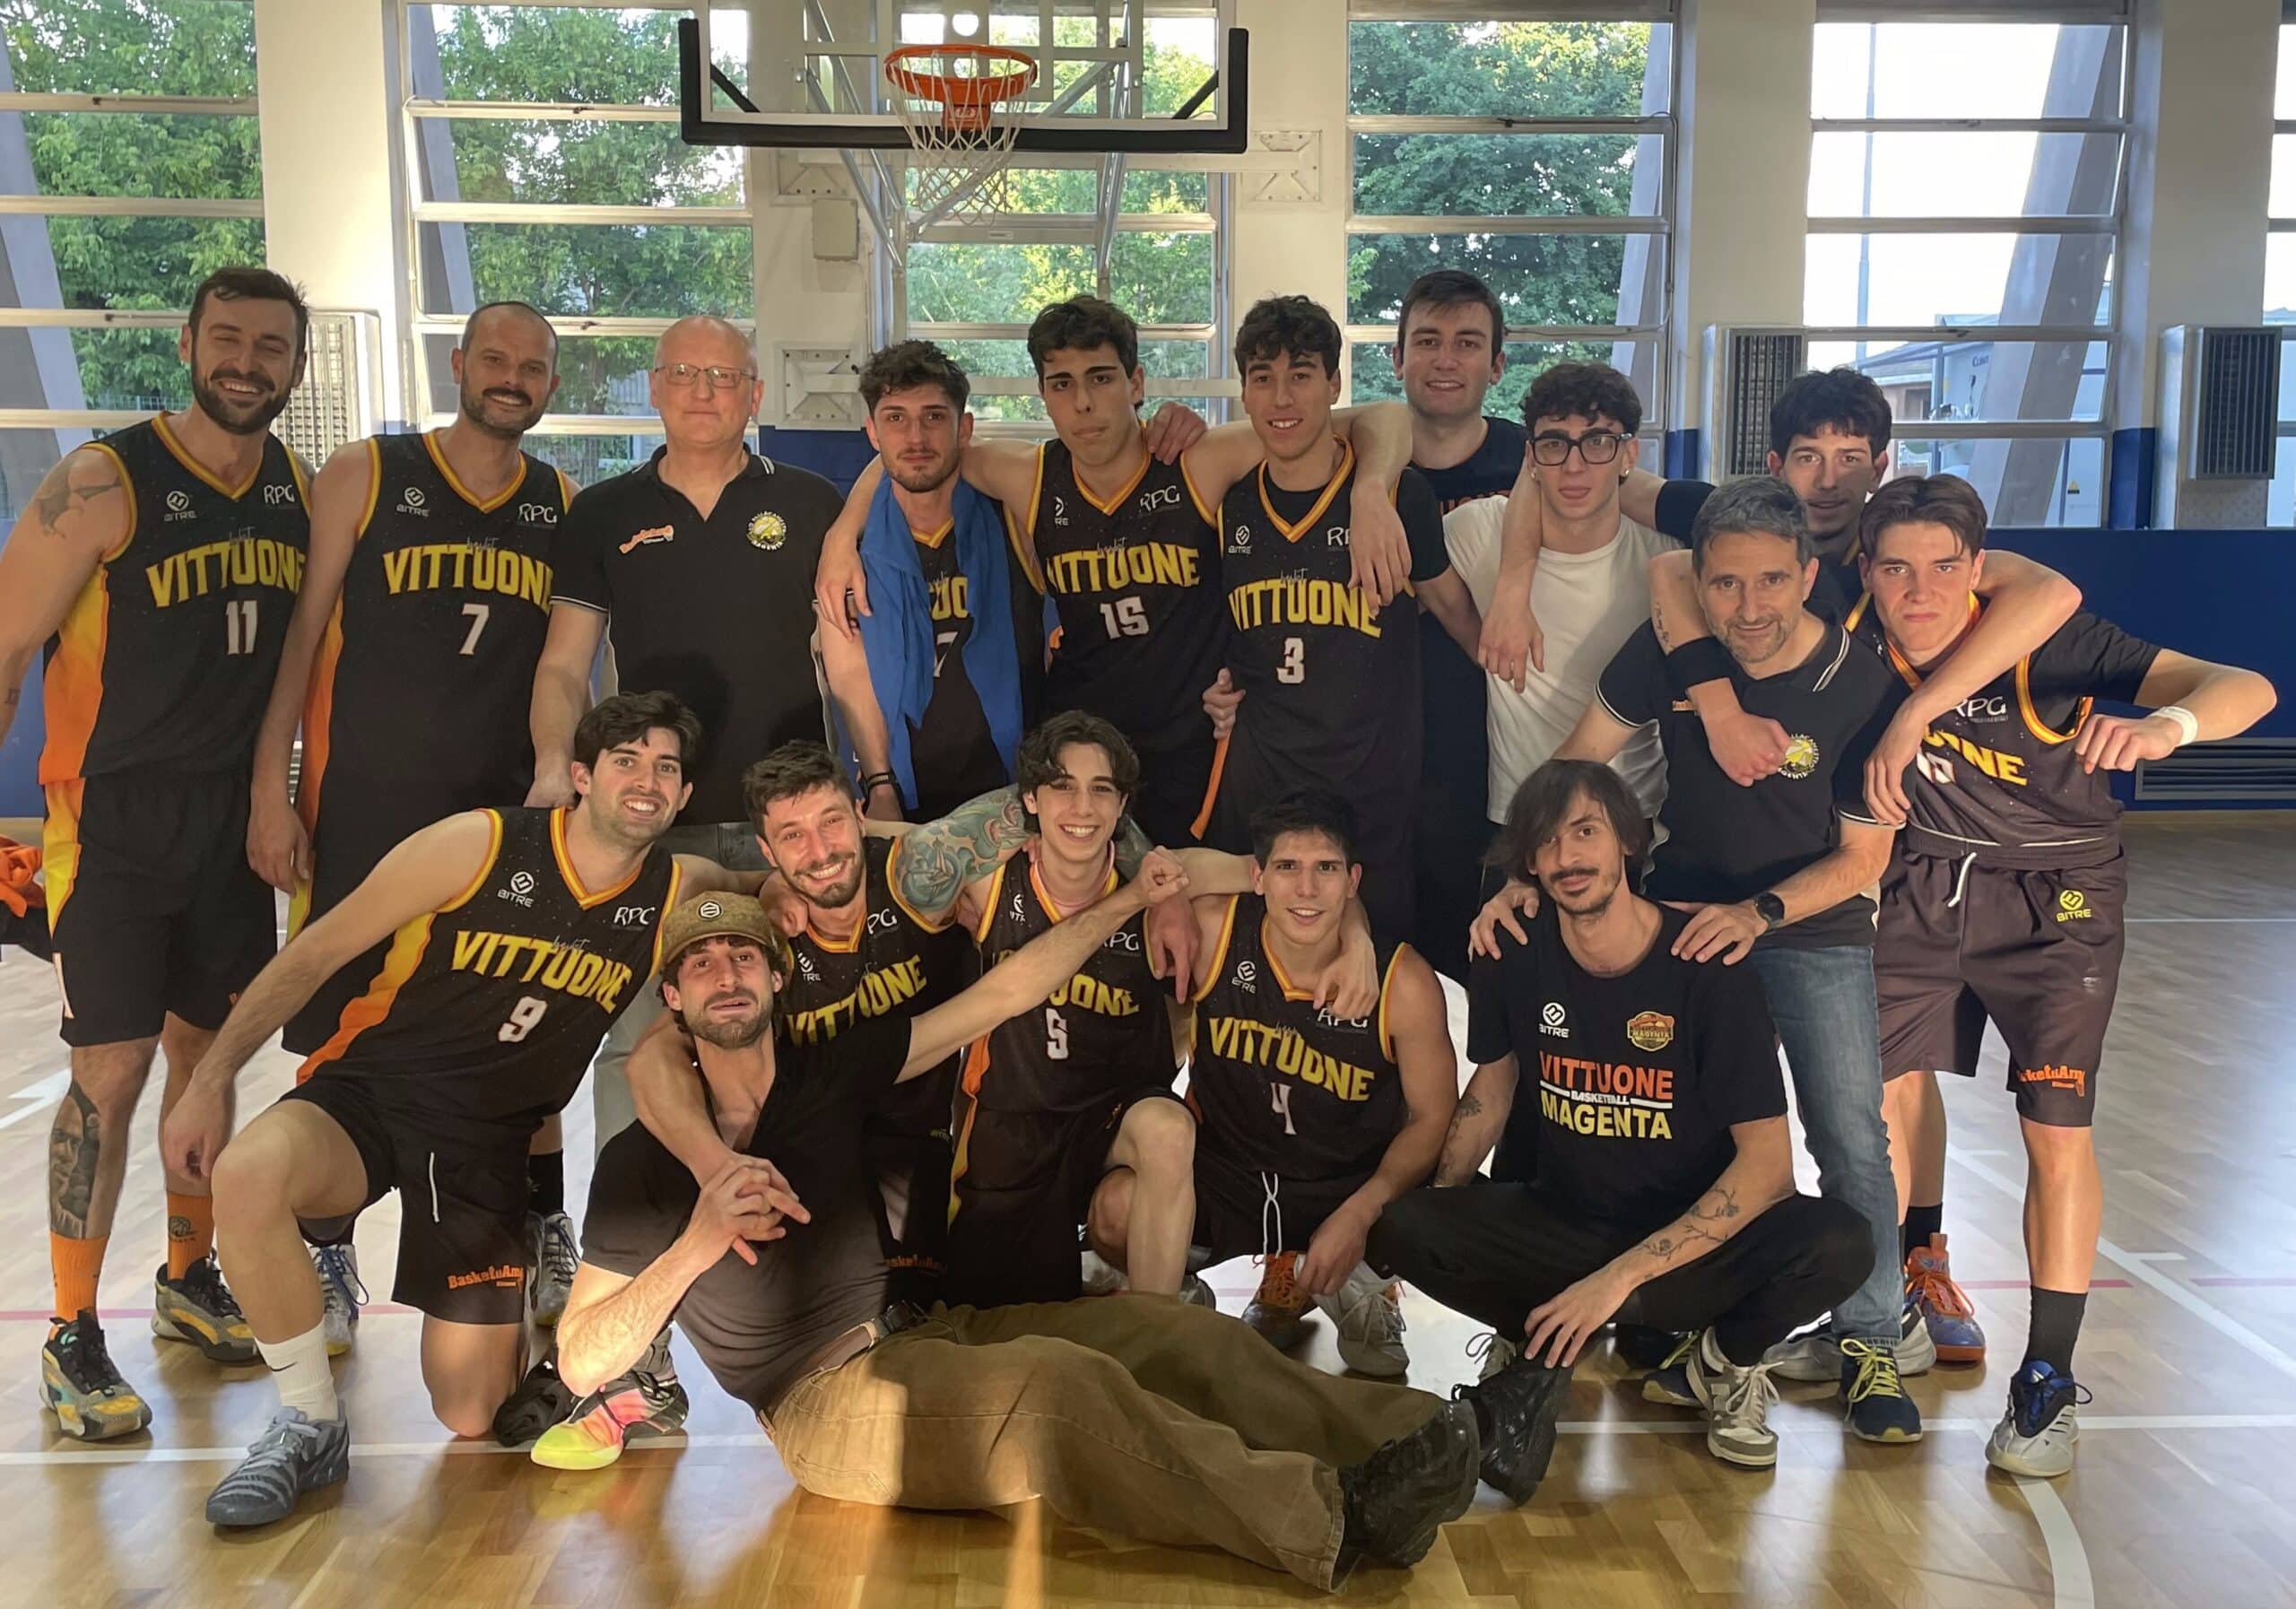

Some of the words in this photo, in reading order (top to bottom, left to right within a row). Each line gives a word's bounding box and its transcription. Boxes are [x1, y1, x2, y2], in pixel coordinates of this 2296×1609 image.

[396, 504, 430, 517] BITRE
[518, 503, 558, 524] RPG
[226, 599, 257, 655] 11
[459, 603, 490, 656] 7
[1100, 596, 1149, 639] 15
[1228, 578, 1382, 639] VITTUONE
[1276, 637, 1305, 683] 3
[497, 889, 535, 908] BITRE
[2057, 909, 2092, 922] BITRE
[867, 909, 897, 935] PG
[1103, 931, 1140, 951] PG
[451, 930, 633, 1014] VITTUONE
[498, 996, 548, 1042] 9
[1046, 1008, 1069, 1059] 5
[1539, 1023, 1570, 1038] BITRE
[1209, 1016, 1375, 1101] VITTUONE
[1539, 1050, 1674, 1100] VITTUONE
[1270, 1082, 1298, 1135] 4
[1541, 1090, 1673, 1139] MAGENTA
[1571, 1090, 1631, 1105] BASKETBALL
